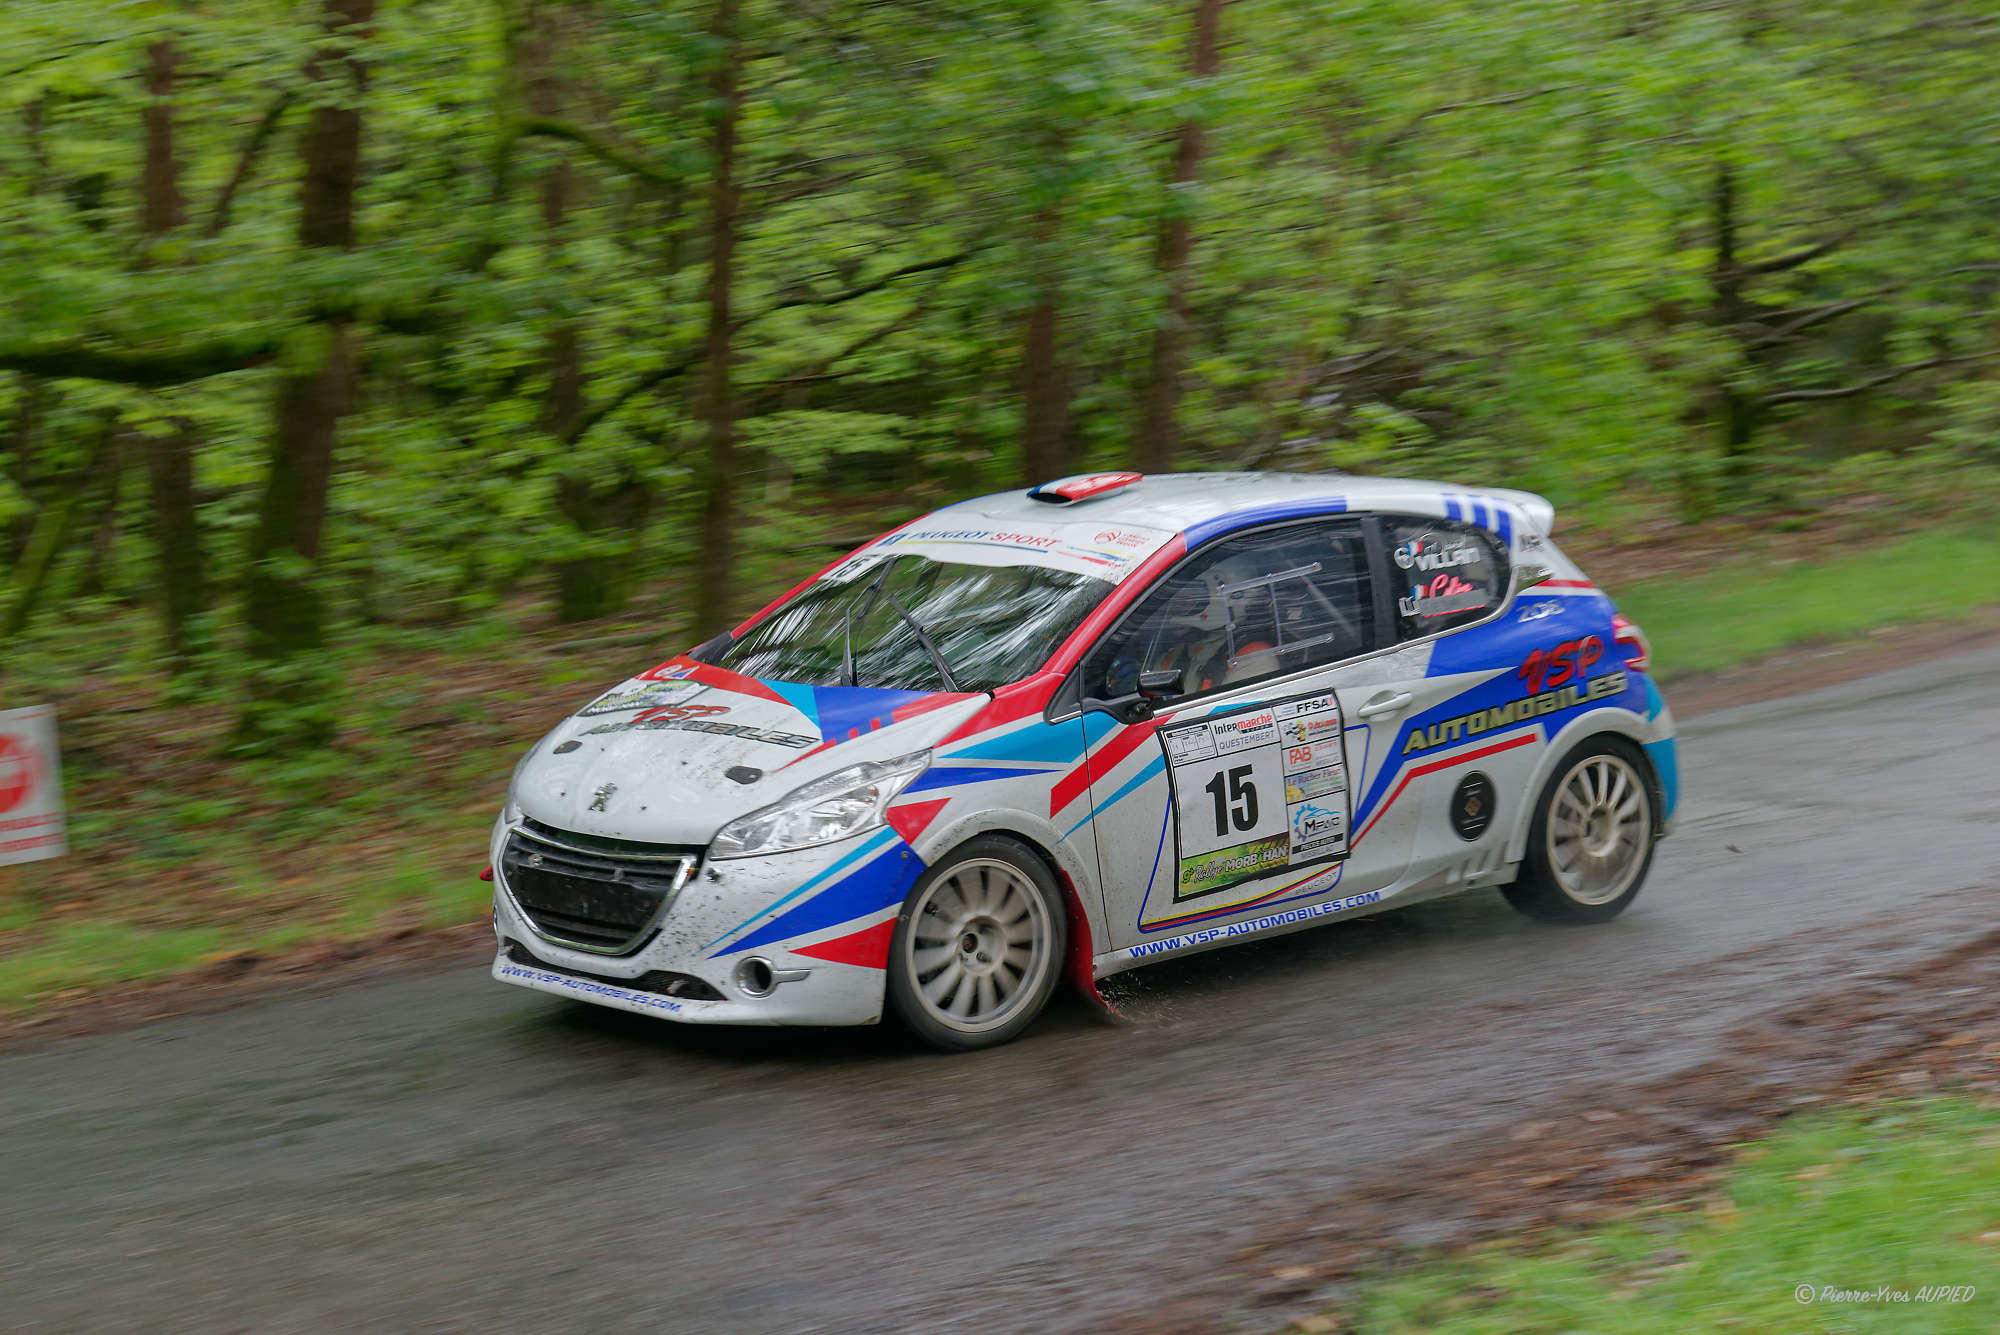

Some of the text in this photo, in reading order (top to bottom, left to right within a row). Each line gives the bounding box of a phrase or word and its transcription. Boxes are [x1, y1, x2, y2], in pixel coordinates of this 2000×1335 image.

[989, 531, 1063, 548] SPORT
[1518, 634, 1605, 696] VSP
[1296, 698, 1329, 714] FFSA
[1402, 670, 1629, 757] AUTOMOBILES
[1219, 730, 1275, 750] QUESTEMBERT
[1288, 746, 1312, 766] FAB
[1206, 764, 1259, 838] 15
[1129, 890, 1381, 958] WWW.VSP-AUTOMOBILES.COM
[501, 966, 682, 1013] WWW.VSP-AUTOMOBILES.COM
